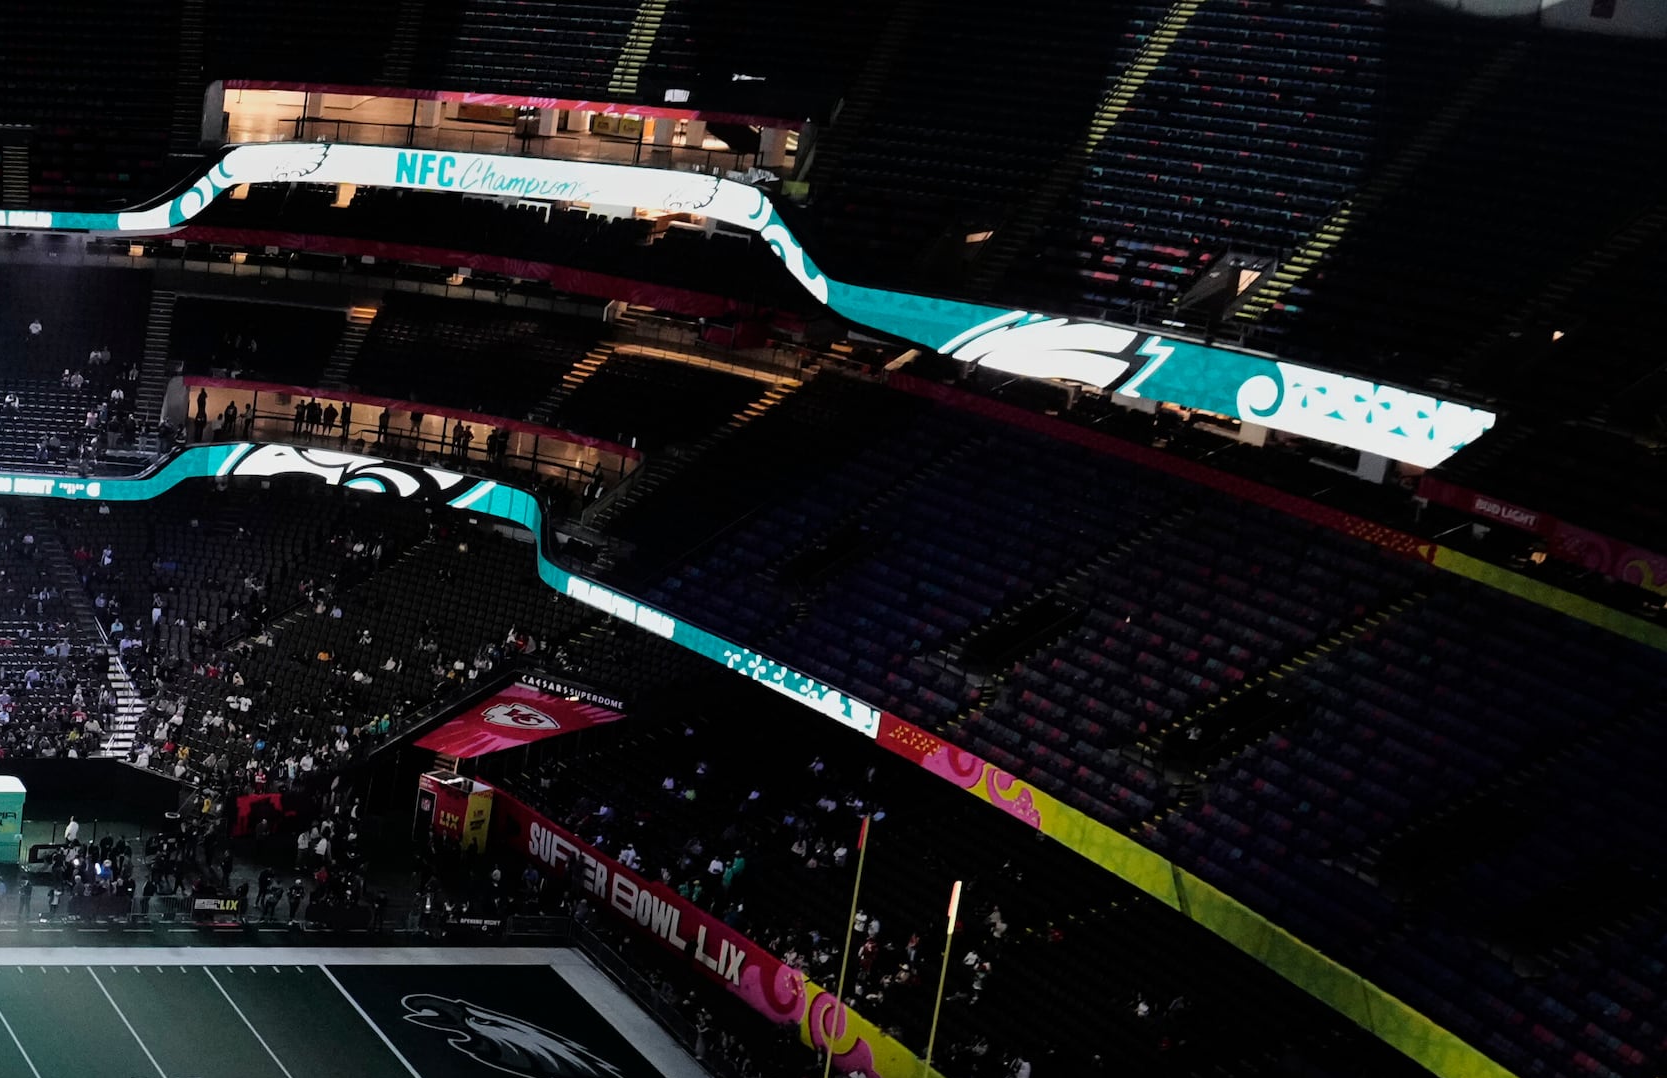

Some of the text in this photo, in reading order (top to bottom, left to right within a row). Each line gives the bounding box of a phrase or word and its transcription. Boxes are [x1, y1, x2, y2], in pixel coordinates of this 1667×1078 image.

[395, 152, 456, 187] NFC
[1474, 499, 1536, 526] BUD LIGHT
[522, 675, 624, 710] CAESARS SUPERDOME
[439, 810, 459, 830] LIX
[219, 899, 238, 911] LIX
[611, 872, 687, 951] BOWL
[695, 925, 746, 986] LIX
